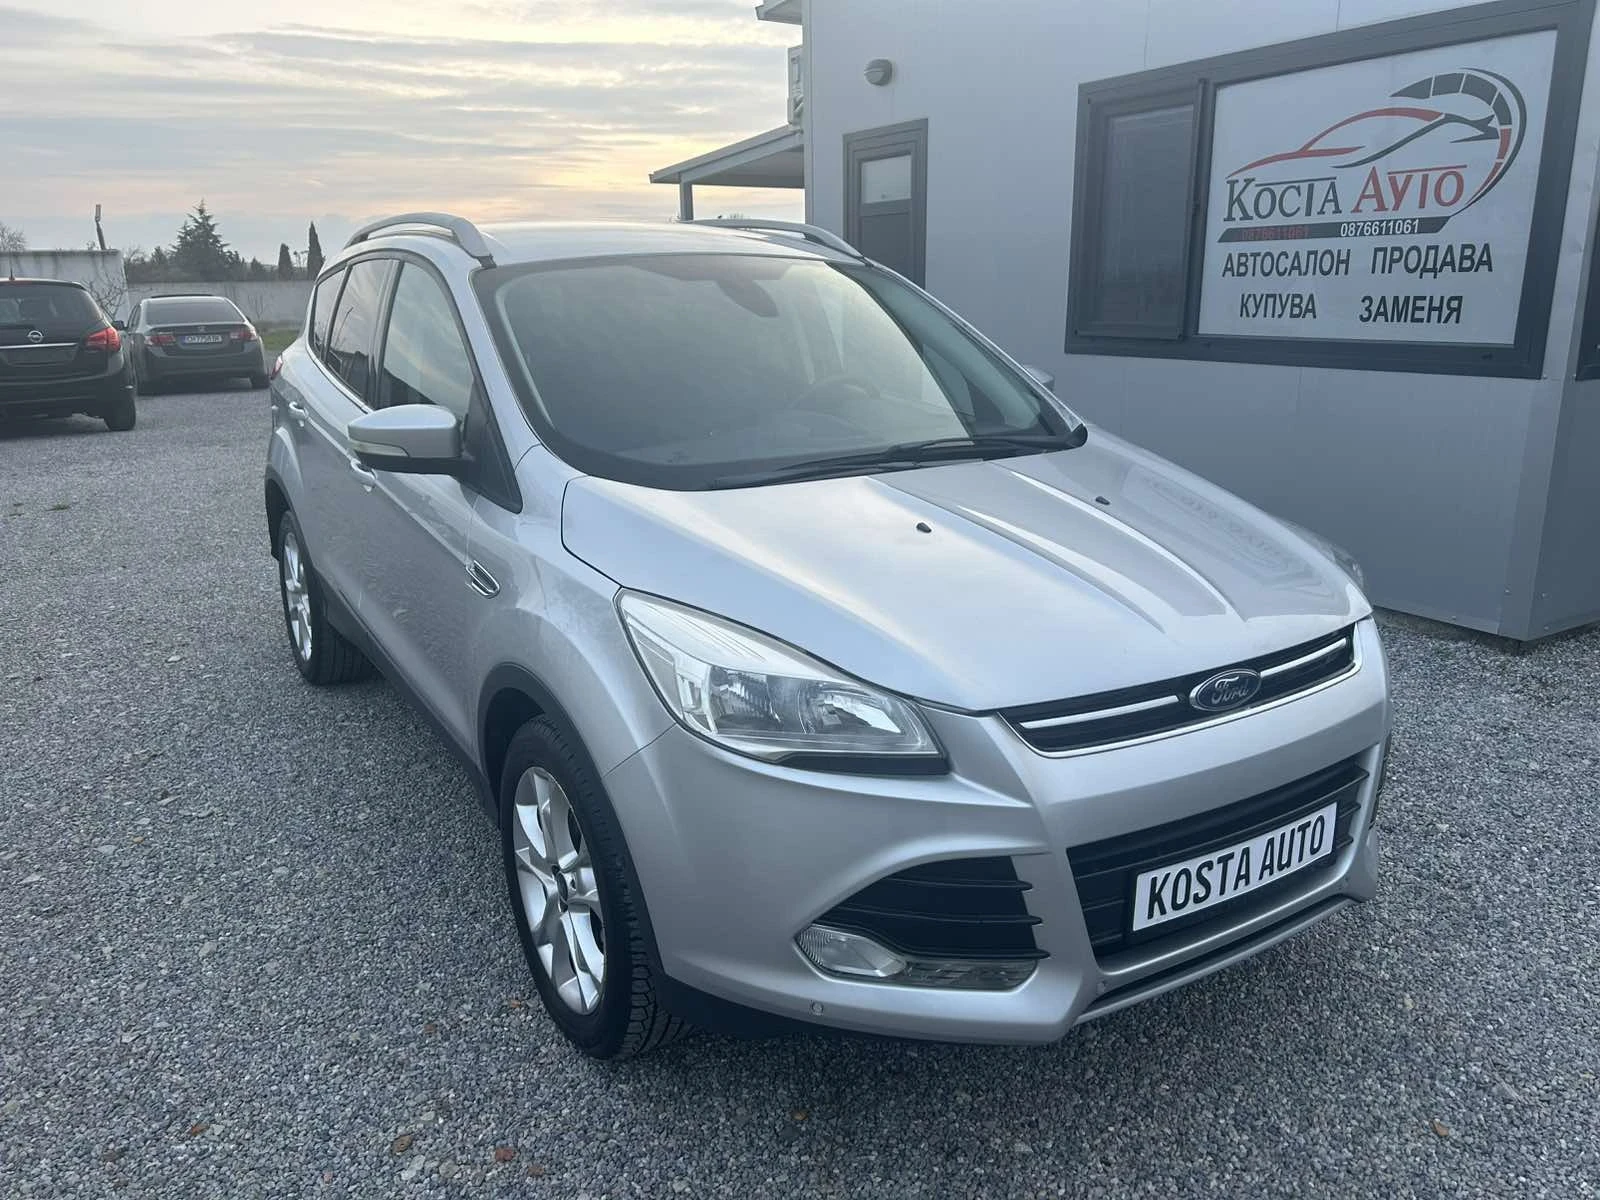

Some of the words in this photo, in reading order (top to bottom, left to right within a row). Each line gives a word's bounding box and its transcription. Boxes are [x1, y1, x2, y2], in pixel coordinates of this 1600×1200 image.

[1340, 219, 1419, 237] 0876611061
[1222, 249, 1350, 277] АВТОСАЛОН
[1371, 243, 1493, 279] ПРОДАВА
[1239, 293, 1317, 319] КУПУВА
[1359, 295, 1463, 324] ЗАМЕНЯ
[1211, 676, 1250, 704] Ford
[1147, 846, 1251, 920] KOSTA
[1258, 814, 1325, 881] AUTO
